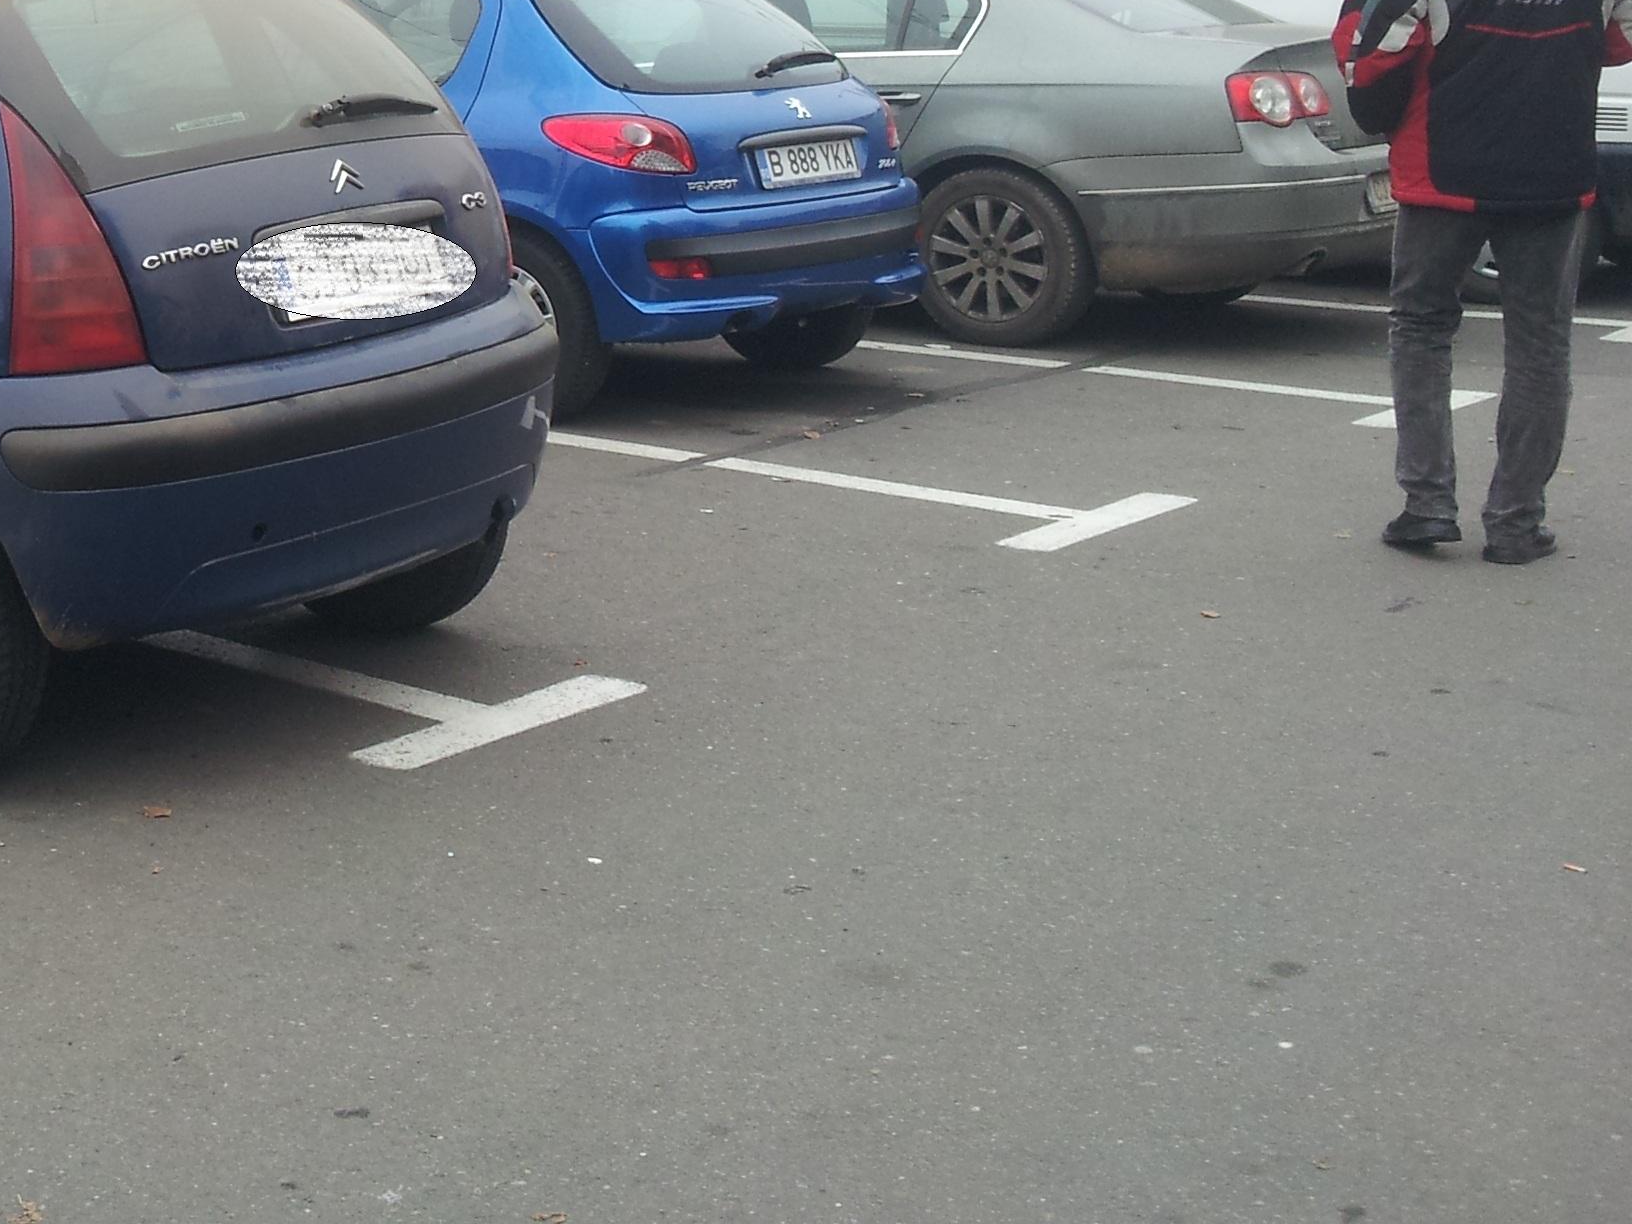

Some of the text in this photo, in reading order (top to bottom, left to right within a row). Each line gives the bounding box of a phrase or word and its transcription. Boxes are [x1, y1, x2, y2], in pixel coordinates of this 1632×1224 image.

[769, 142, 855, 177] B 888 YKA
[686, 178, 739, 191] PEUGEOT
[141, 237, 239, 270] CITROËN
